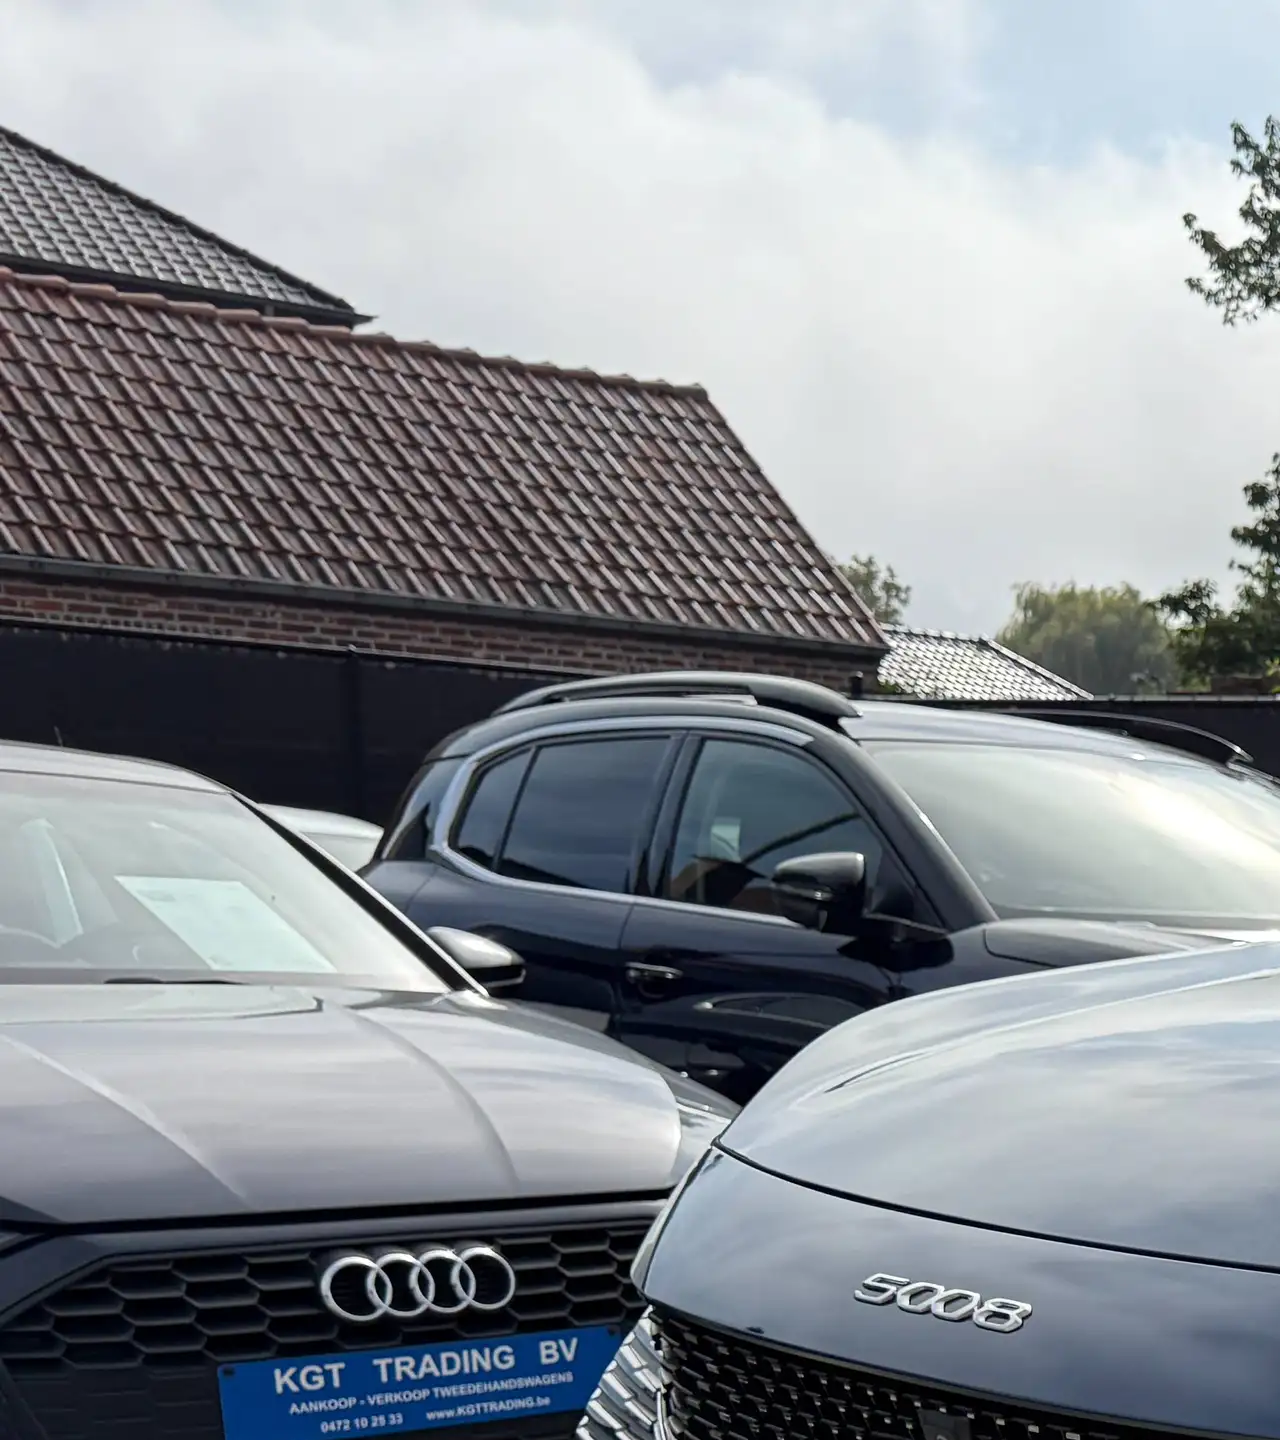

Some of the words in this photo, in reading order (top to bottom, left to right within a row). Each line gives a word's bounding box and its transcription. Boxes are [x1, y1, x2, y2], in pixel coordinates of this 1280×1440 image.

[854, 1273, 1032, 1332] 5008
[274, 1362, 346, 1395] KGT
[373, 1345, 515, 1383] TRADING
[538, 1337, 579, 1365] BV
[289, 1396, 357, 1415] AANKOOP
[366, 1388, 430, 1407] VERKOOP
[433, 1371, 574, 1399] TWEEDEHANDSWAGENS
[320, 1418, 350, 1433] 0472
[354, 1416, 369, 1430] 10
[388, 1412, 404, 1426] 33
[426, 1396, 551, 1421] www.KGTTRADING.be
